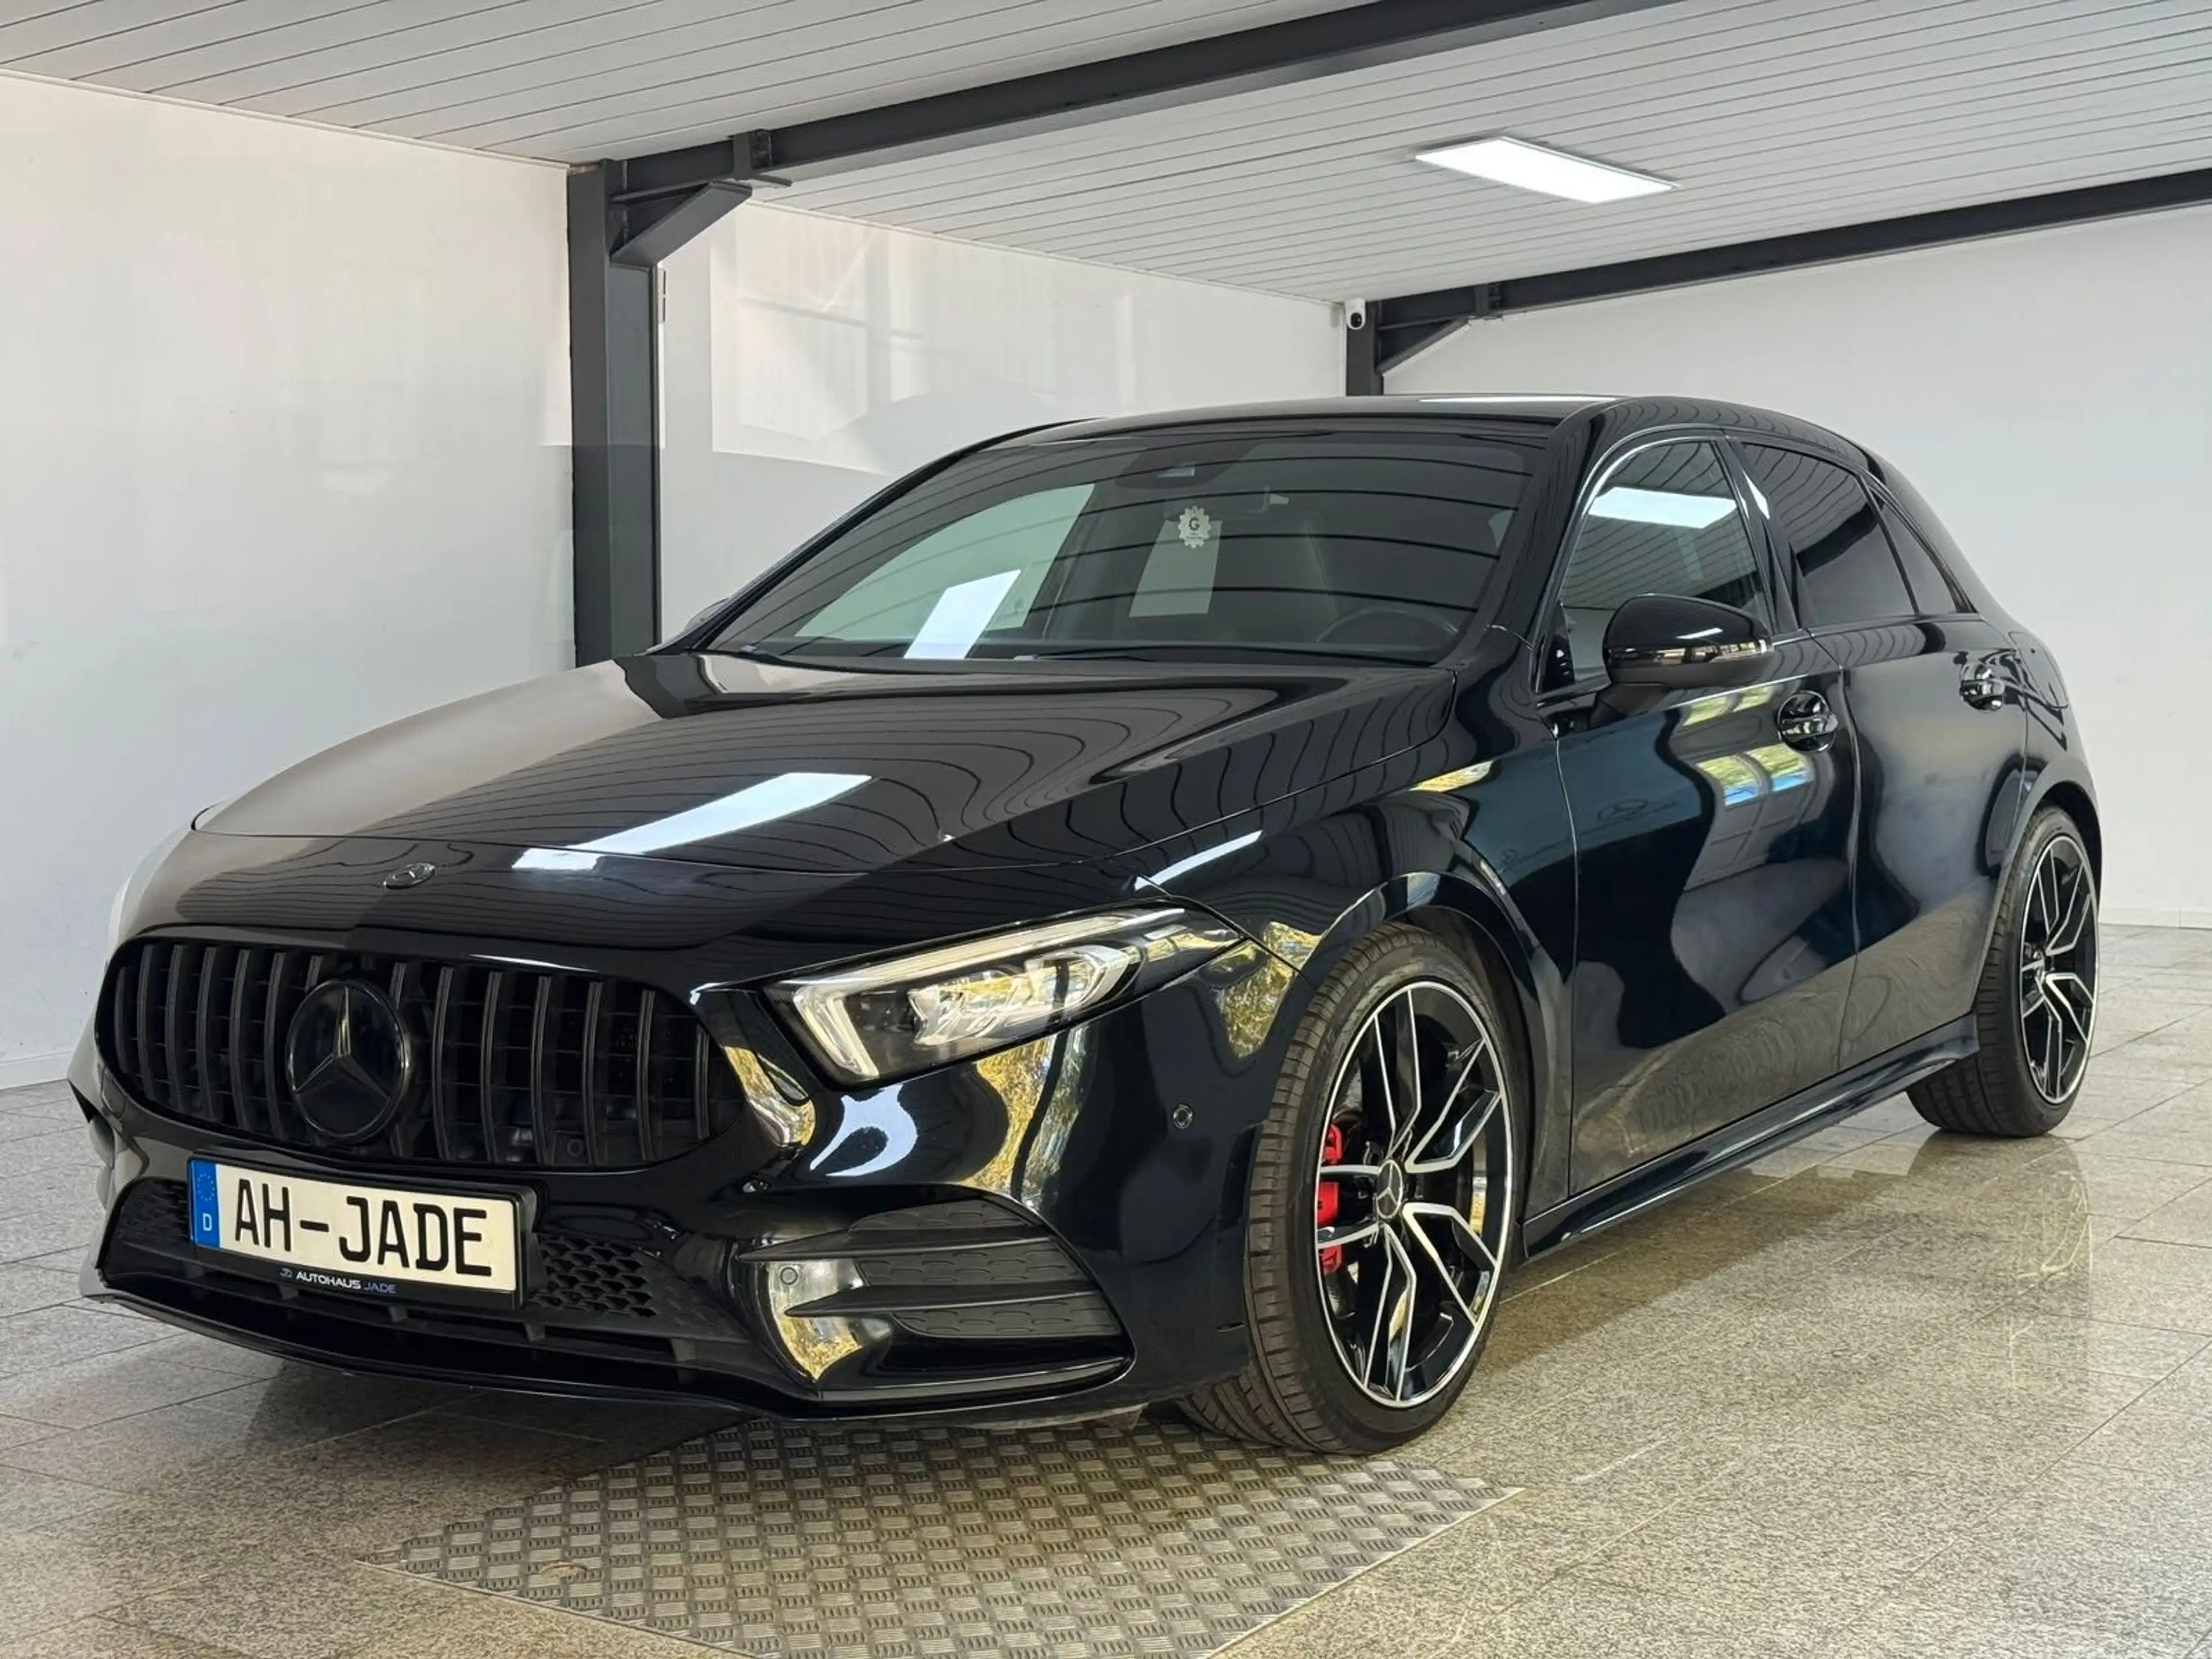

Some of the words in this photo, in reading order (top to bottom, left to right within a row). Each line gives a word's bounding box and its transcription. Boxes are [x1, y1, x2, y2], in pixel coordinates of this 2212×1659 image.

[1188, 516, 1200, 531] G
[203, 1213, 213, 1231] D
[235, 1178, 492, 1277] AH-JADE
[296, 1270, 362, 1290] AUTOHAUS
[363, 1282, 396, 1294] JADE
